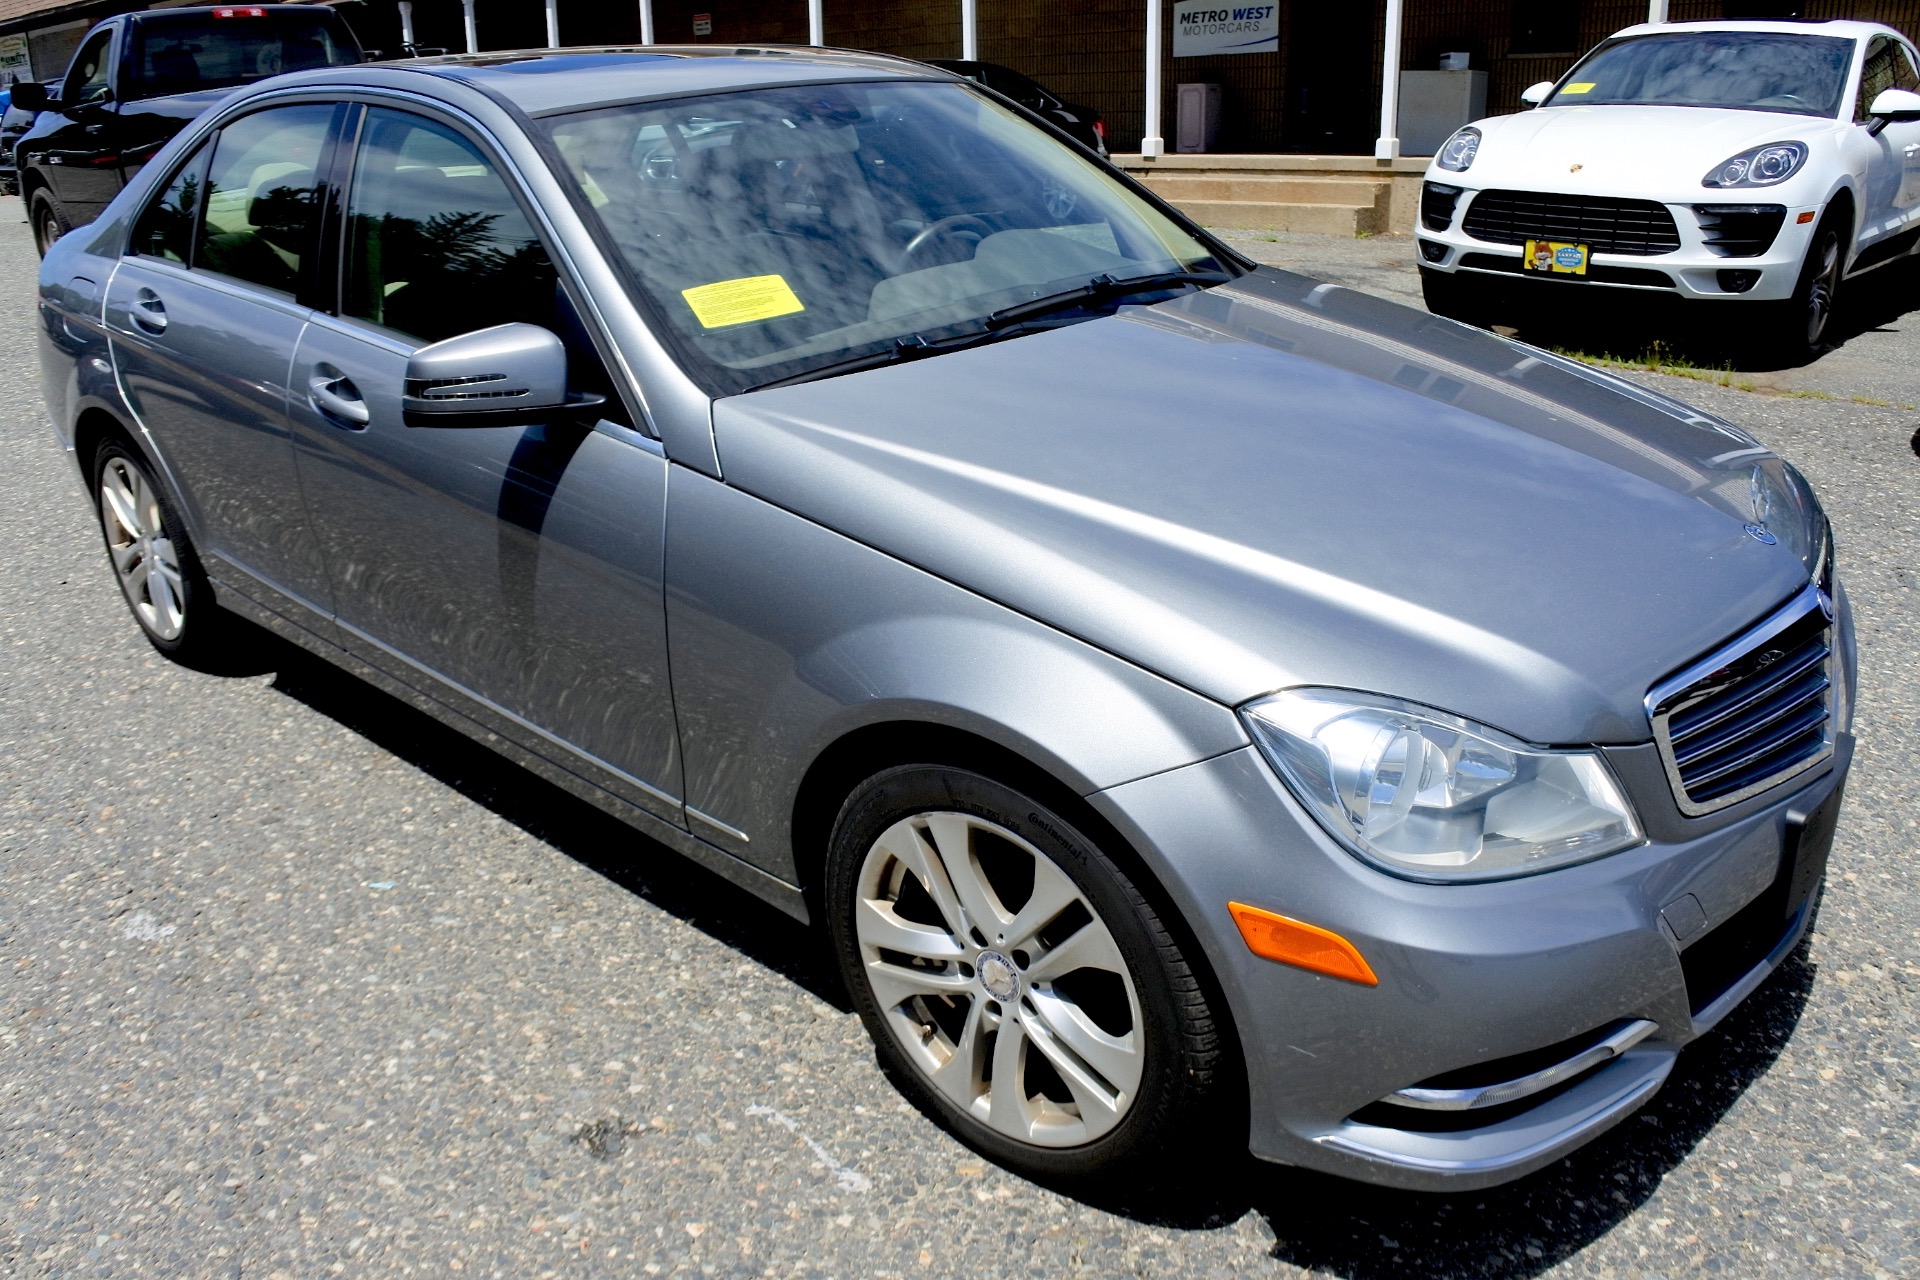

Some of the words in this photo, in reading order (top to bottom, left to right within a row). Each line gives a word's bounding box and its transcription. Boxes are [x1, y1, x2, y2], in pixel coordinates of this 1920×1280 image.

[1180, 10, 1228, 24] METRO
[1233, 6, 1273, 20] WEST
[1183, 21, 1260, 36] MOTORCARS
[1028, 812, 1082, 859] Continental
